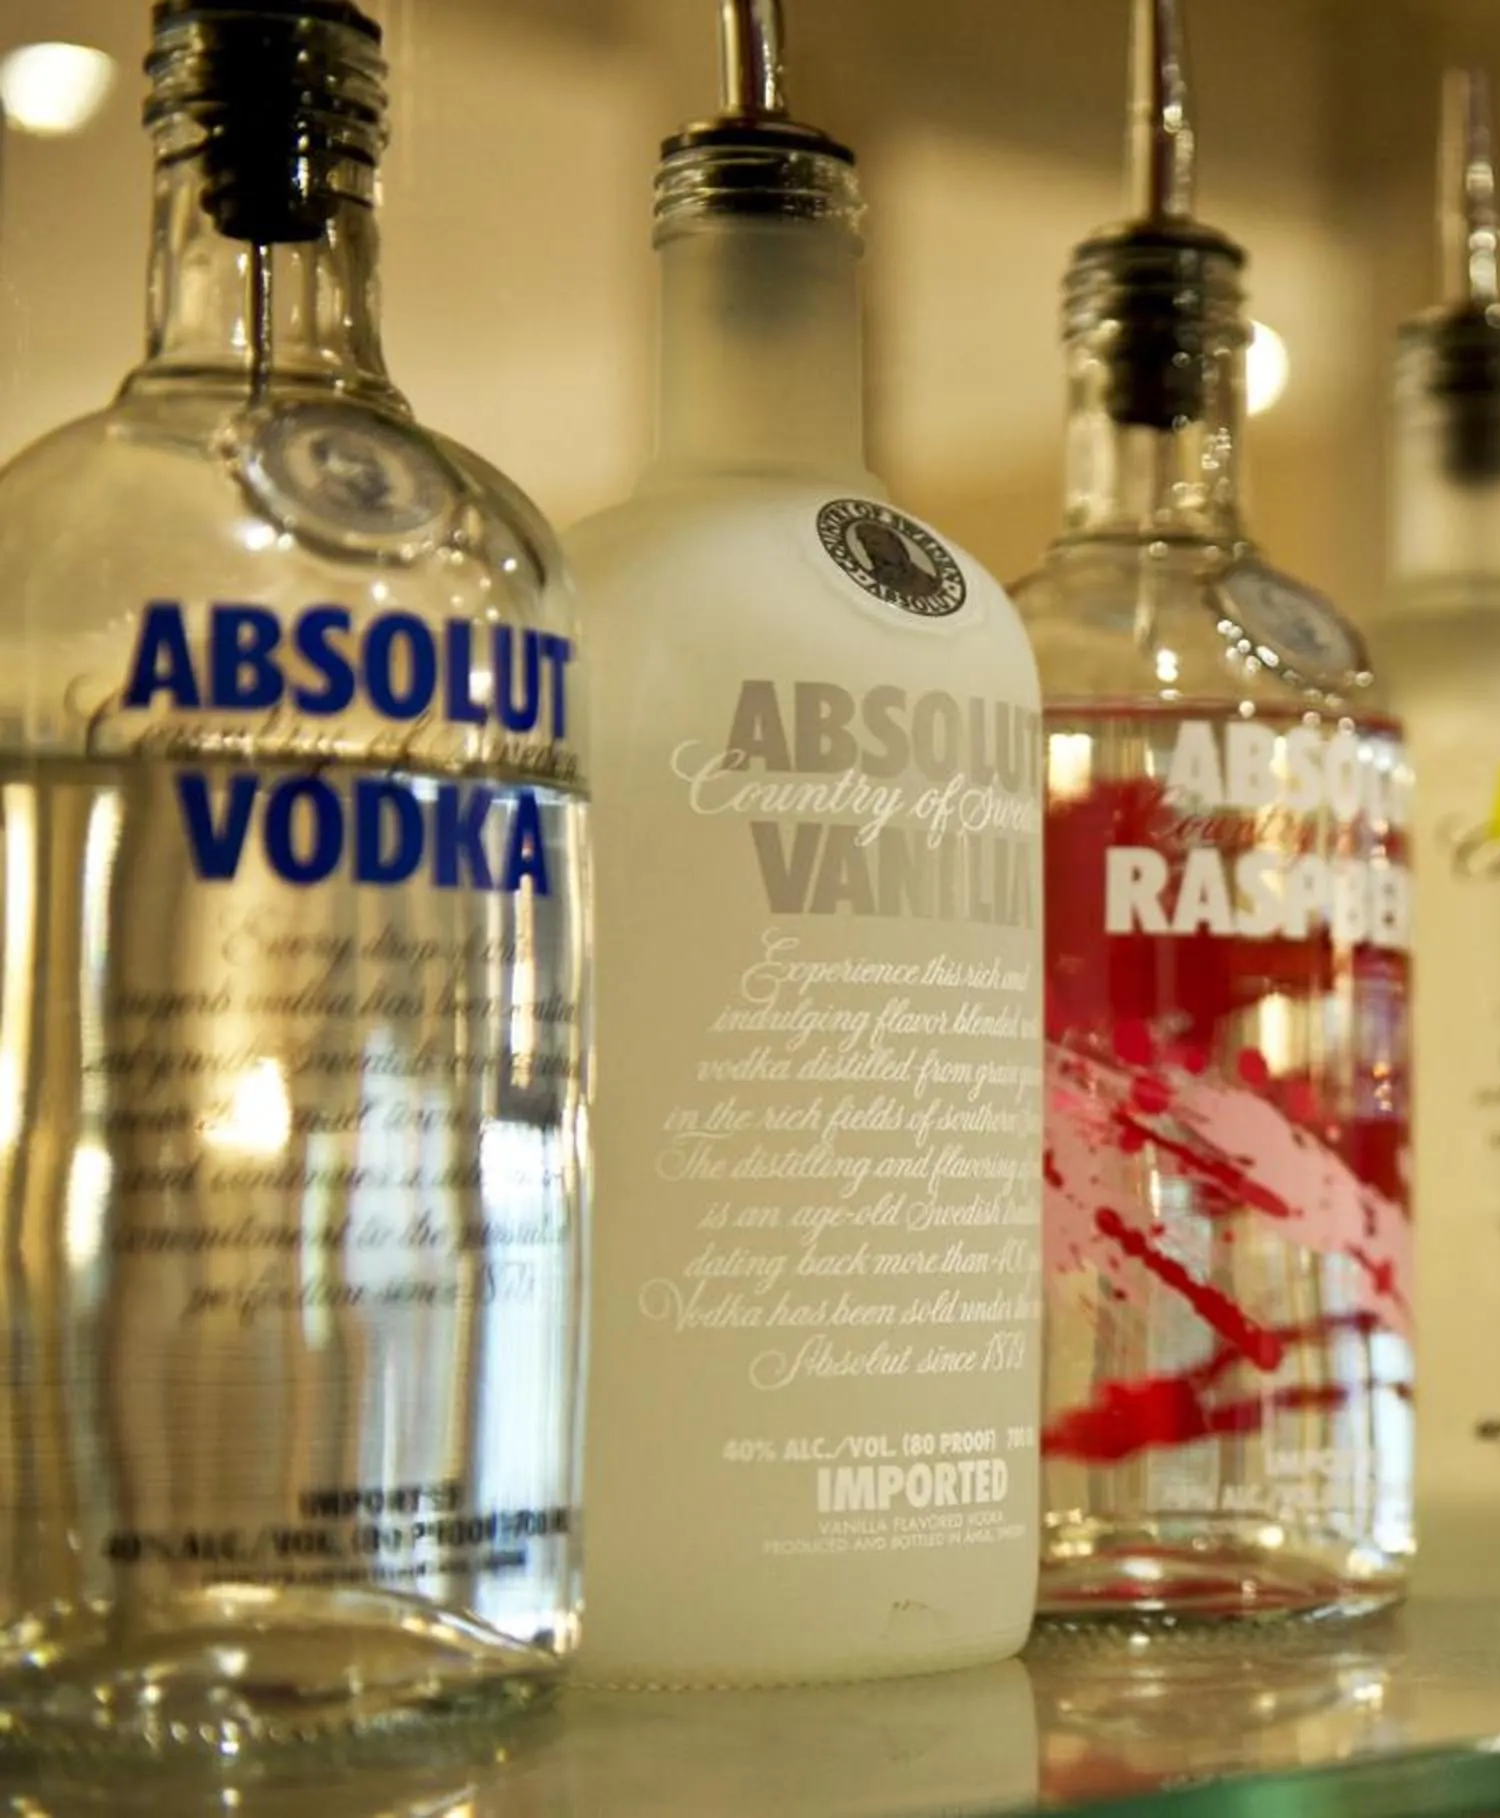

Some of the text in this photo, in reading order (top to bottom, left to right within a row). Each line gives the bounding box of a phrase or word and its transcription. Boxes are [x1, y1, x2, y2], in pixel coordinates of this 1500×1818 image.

[121, 598, 573, 740] ABSOLUT
[670, 738, 904, 849] Country
[904, 772, 964, 849] of
[175, 773, 550, 897] VODKA
[741, 927, 921, 1003] Experience
[920, 952, 964, 988] this
[966, 957, 1002, 990] rich
[707, 998, 872, 1052] indulging
[870, 997, 950, 1051] flavor
[697, 1047, 791, 1083] vodka
[796, 1045, 918, 1083] distilled
[911, 1047, 973, 1100] from
[661, 1105, 700, 1132] in
[701, 1096, 755, 1132] the
[756, 1098, 824, 1133] rich
[821, 1094, 906, 1146] fields
[903, 1097, 940, 1148] of
[655, 1130, 724, 1182] The
[727, 1140, 873, 1199] distilling
[872, 1142, 935, 1179] and
[697, 1201, 733, 1230] is
[734, 1206, 781, 1229] an
[789, 1193, 904, 1247] age-old
[904, 1192, 1003, 1232] Swedish
[683, 1240, 788, 1296] dating
[797, 1240, 870, 1278] back
[871, 1250, 941, 1276] more
[940, 1238, 990, 1275] than
[638, 1278, 764, 1335] Vodka
[764, 1288, 830, 1328] has
[828, 1292, 898, 1326] been
[898, 1286, 961, 1326] sold
[748, 1333, 916, 1390] Absolut
[914, 1344, 979, 1374] since
[721, 1437, 776, 1462] 40%
[783, 1433, 897, 1461] ALC./VOL.
[901, 1431, 936, 1457] (80
[939, 1427, 996, 1455] PROOF)
[816, 1457, 1009, 1514] IMPORTED
[816, 1517, 888, 1537] VANILLA
